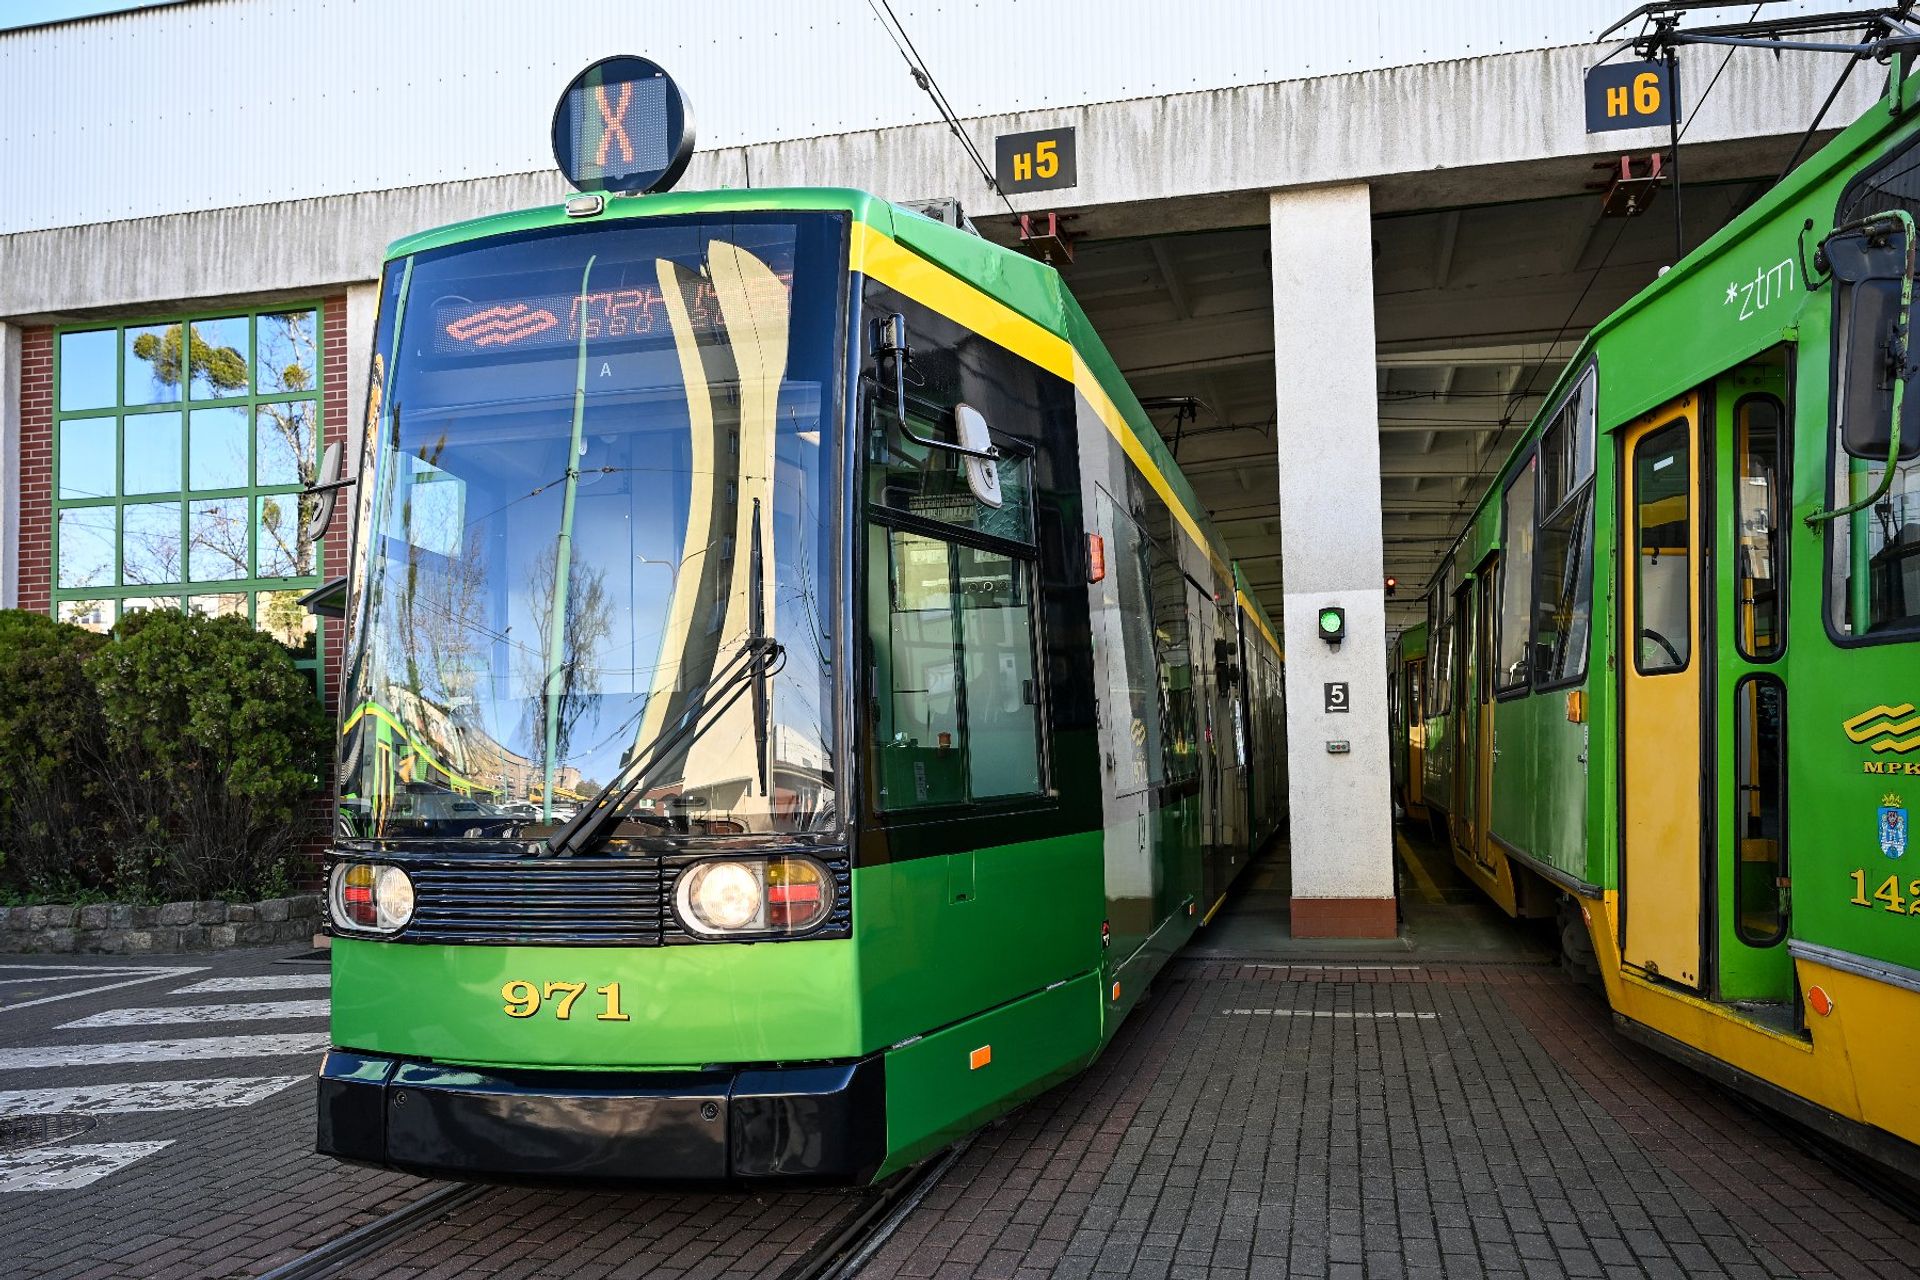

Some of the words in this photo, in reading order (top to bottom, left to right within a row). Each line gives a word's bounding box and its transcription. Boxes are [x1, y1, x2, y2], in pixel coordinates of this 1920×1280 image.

[1607, 72, 1660, 117] H6
[595, 81, 633, 167] X
[1013, 140, 1059, 181] H5
[1331, 684, 1344, 703] 5
[1863, 761, 1920, 775] MPK
[501, 981, 630, 1021] 971
